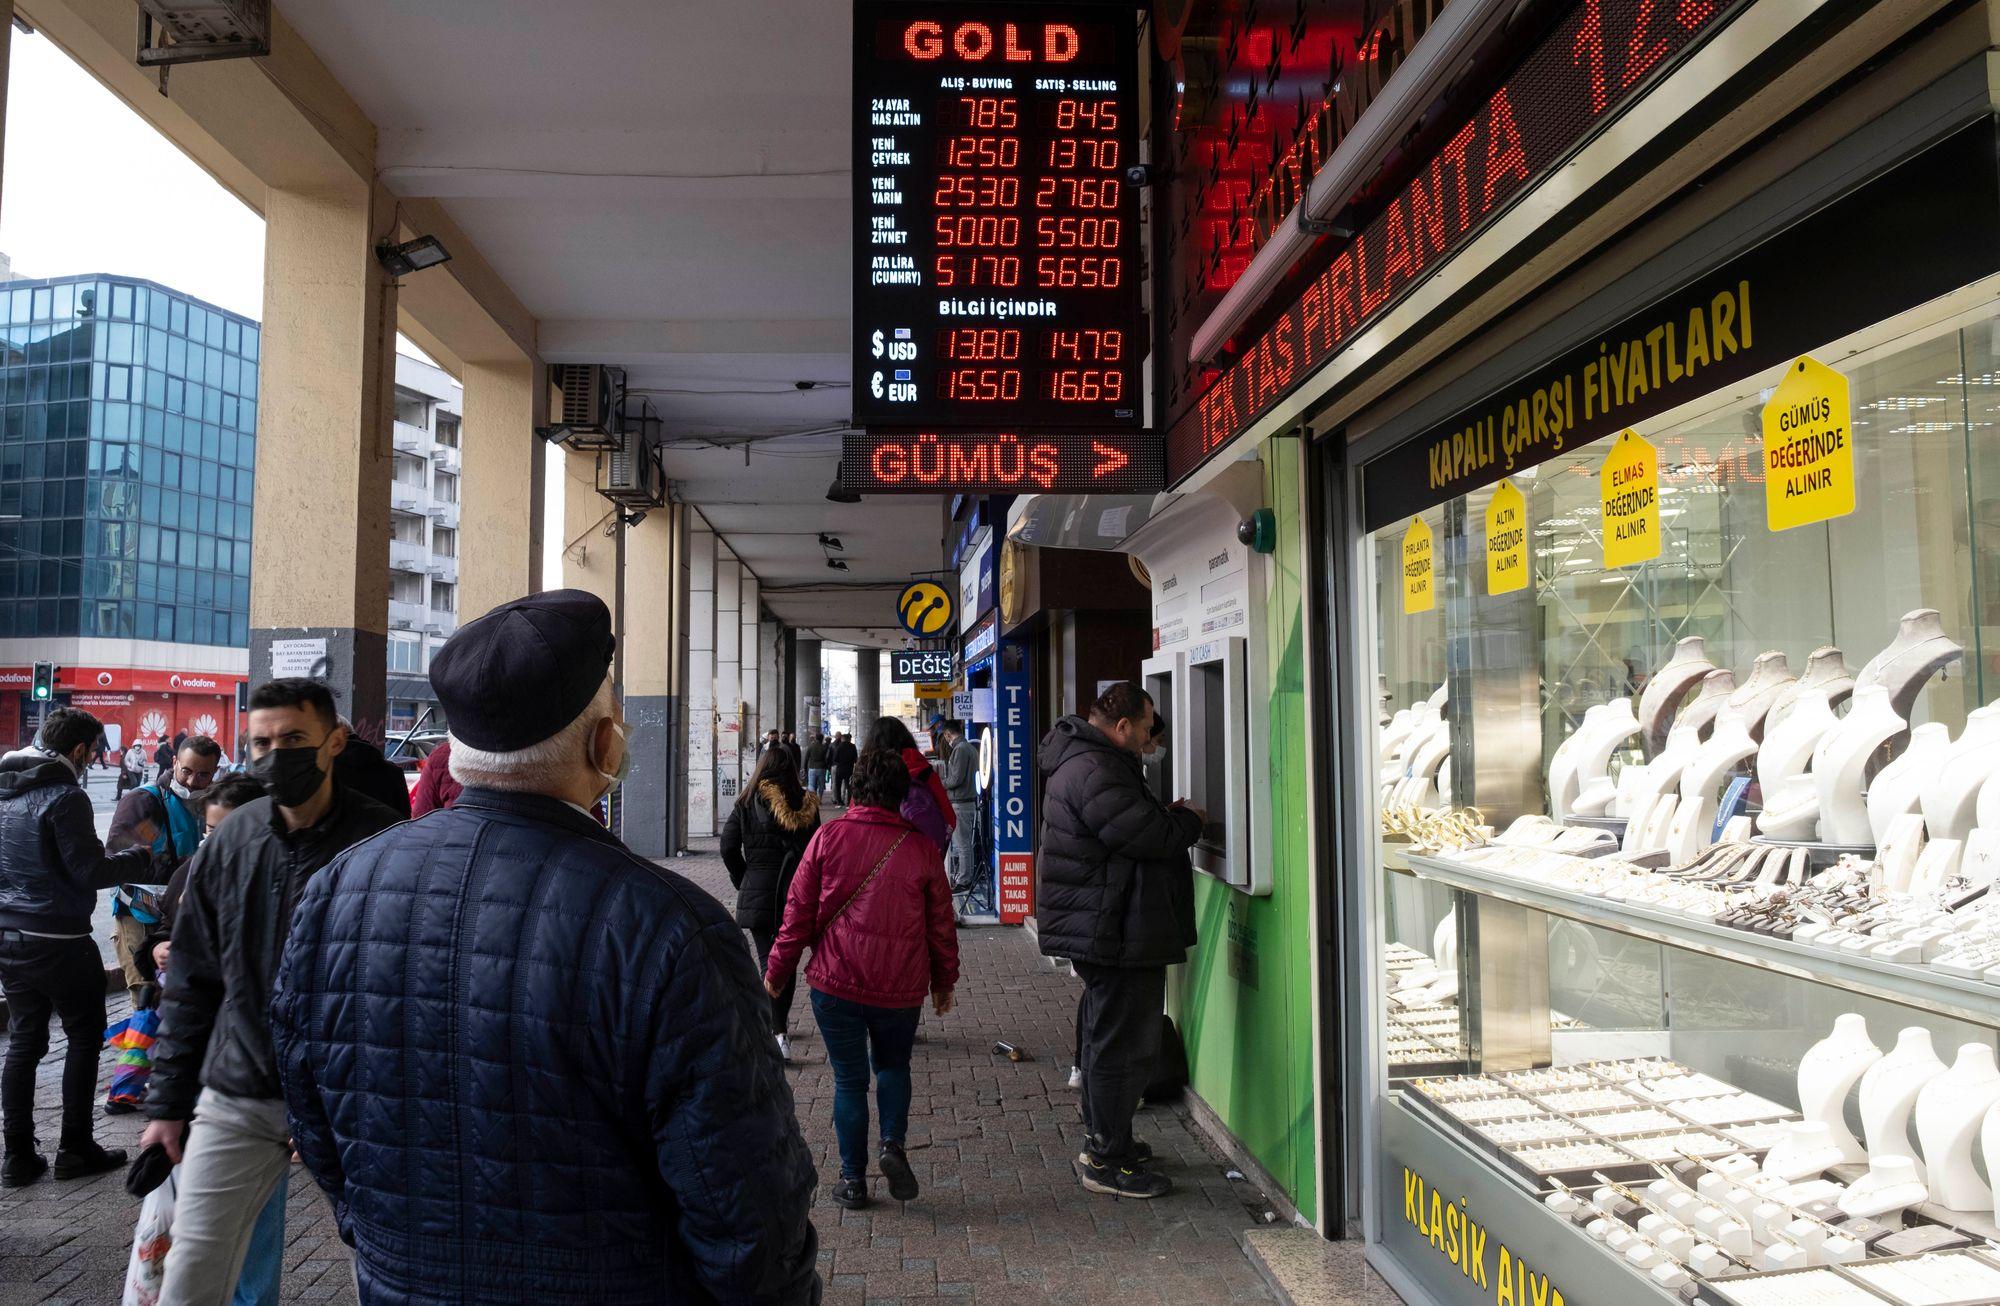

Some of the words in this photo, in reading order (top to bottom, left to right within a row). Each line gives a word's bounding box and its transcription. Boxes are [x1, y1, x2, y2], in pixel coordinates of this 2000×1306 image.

[904, 21, 1079, 62] GOLD
[972, 78, 1013, 90] BUYING
[1073, 80, 1117, 91] SELLING
[871, 99, 883, 111] 24
[885, 99, 910, 112] AYAR
[960, 98, 1017, 128] 785
[1057, 100, 1117, 130] 845
[871, 113, 892, 126] HAS
[892, 113, 921, 126] ALTIN
[871, 135, 896, 151] YENİ
[949, 137, 1018, 168] 1250
[1049, 139, 1119, 169] 1370
[871, 152, 911, 167] ÇEYREK
[871, 174, 896, 190] YENİ
[935, 176, 1019, 207] 2530
[1036, 178, 1119, 208] 2760
[871, 192, 903, 205] YARIM
[871, 213, 896, 229] YENİ
[936, 216, 1019, 246] 5000
[1038, 218, 1120, 247] 5500
[871, 229, 908, 244] ZİYNET
[871, 256, 890, 269] ATA
[891, 253, 914, 269] LİRA
[936, 256, 1019, 286] 5170
[1038, 257, 1121, 288] 5650
[1199, 367, 1238, 454] TEK
[1302, 87, 1529, 366] PIRLANTA
[871, 270, 921, 286] (CUMHRY)
[939, 297, 985, 316] BİLGİ
[990, 298, 1057, 319] İÇİNDİR
[888, 342, 917, 360] USD
[949, 329, 1020, 360] 13.80
[1051, 331, 1122, 361] 14.79
[888, 384, 917, 402] EUR
[949, 370, 1020, 400] 15.50
[1051, 371, 1122, 401] 16.69
[1429, 415, 1495, 490] KAPALI
[1501, 374, 1573, 471] ÇARŞI
[1583, 280, 1752, 421] FİYATLARI
[1779, 397, 1831, 432] GÜMÜŞ
[1770, 428, 1844, 470] DEĞERİNDE
[871, 434, 1059, 488] GÜMÜŞ
[1612, 461, 1645, 487] ELMAS
[1785, 467, 1832, 499] ALINIR
[1605, 486, 1654, 517] DEĞERİNDE
[1496, 508, 1515, 526] ALTIN
[1489, 527, 1523, 551] DEĞERİNDE
[1615, 518, 1647, 541] ALINIR
[1405, 539, 1429, 556] PIRLANTA
[1496, 554, 1518, 572] ALINIR
[1411, 580, 1427, 595] ALINIR
[0, 674, 31, 683] odafone
[182, 678, 216, 688] vodafone
[1005, 686, 1024, 839] TELEFON
[1004, 862, 1027, 872] ALINIR
[1003, 876, 1028, 886] SATILIR
[1004, 890, 1027, 900] TAKAS
[1003, 902, 1029, 913] YAPILIR
[1404, 1165, 1488, 1292] KLASİK
